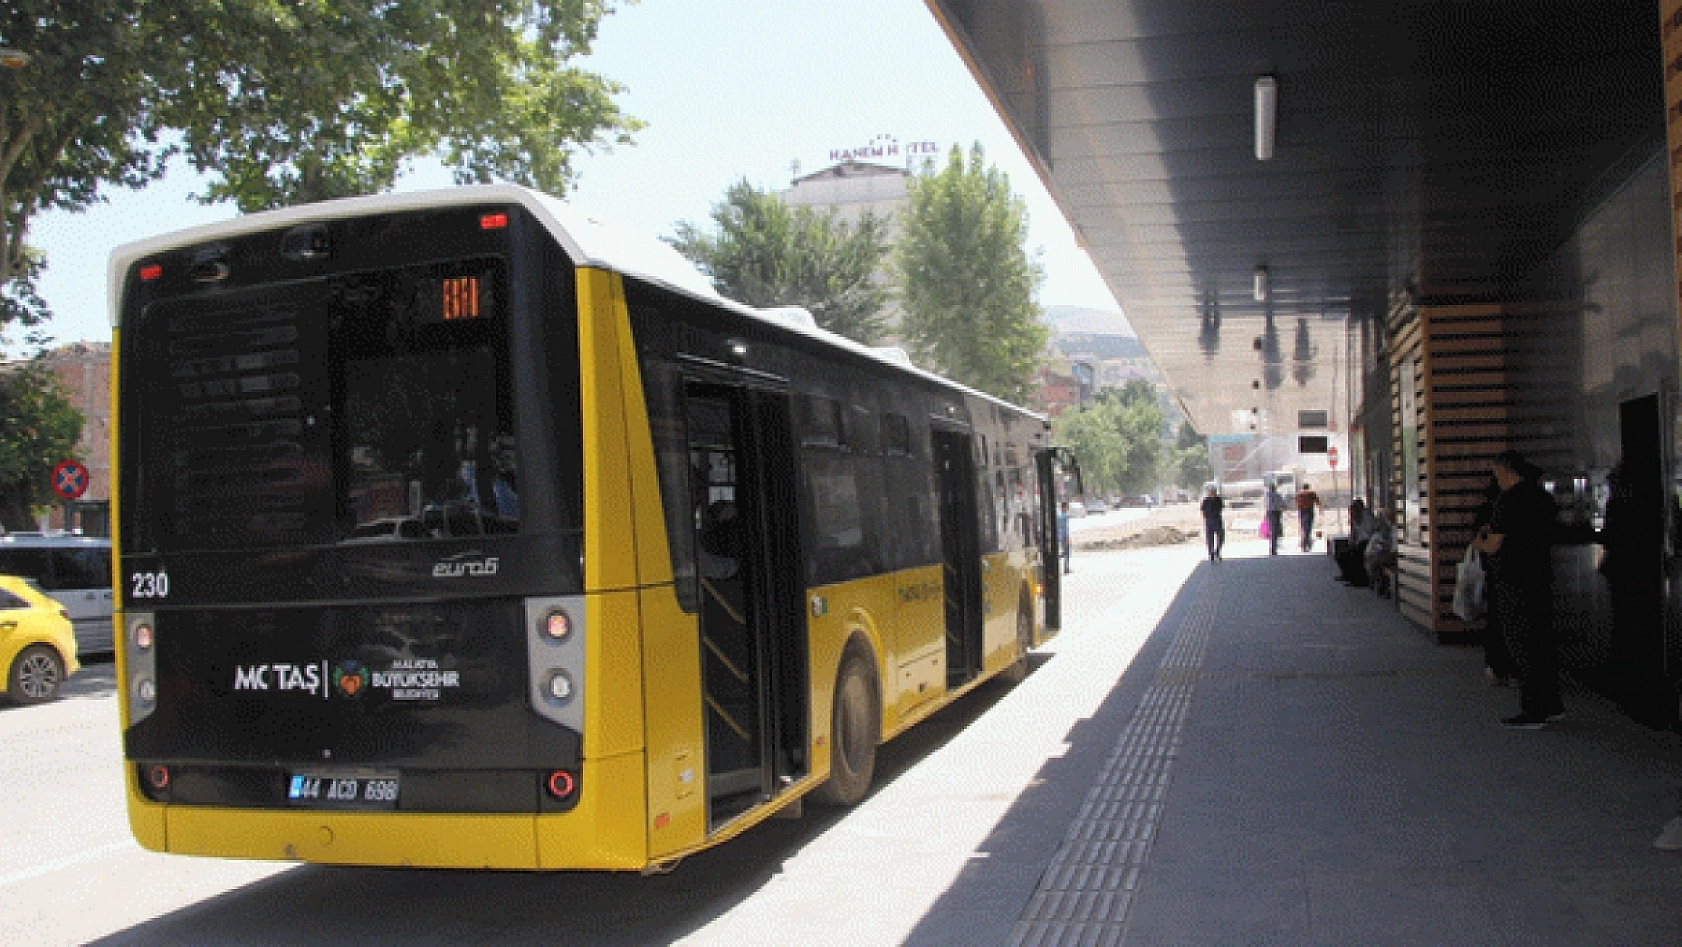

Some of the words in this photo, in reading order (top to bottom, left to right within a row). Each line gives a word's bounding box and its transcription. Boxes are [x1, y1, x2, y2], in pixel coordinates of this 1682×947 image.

[887, 141, 939, 157] HTEL
[132, 572, 168, 598] 230
[303, 779, 320, 799] 44
[327, 779, 358, 800] ACD
[365, 780, 398, 800] 698
